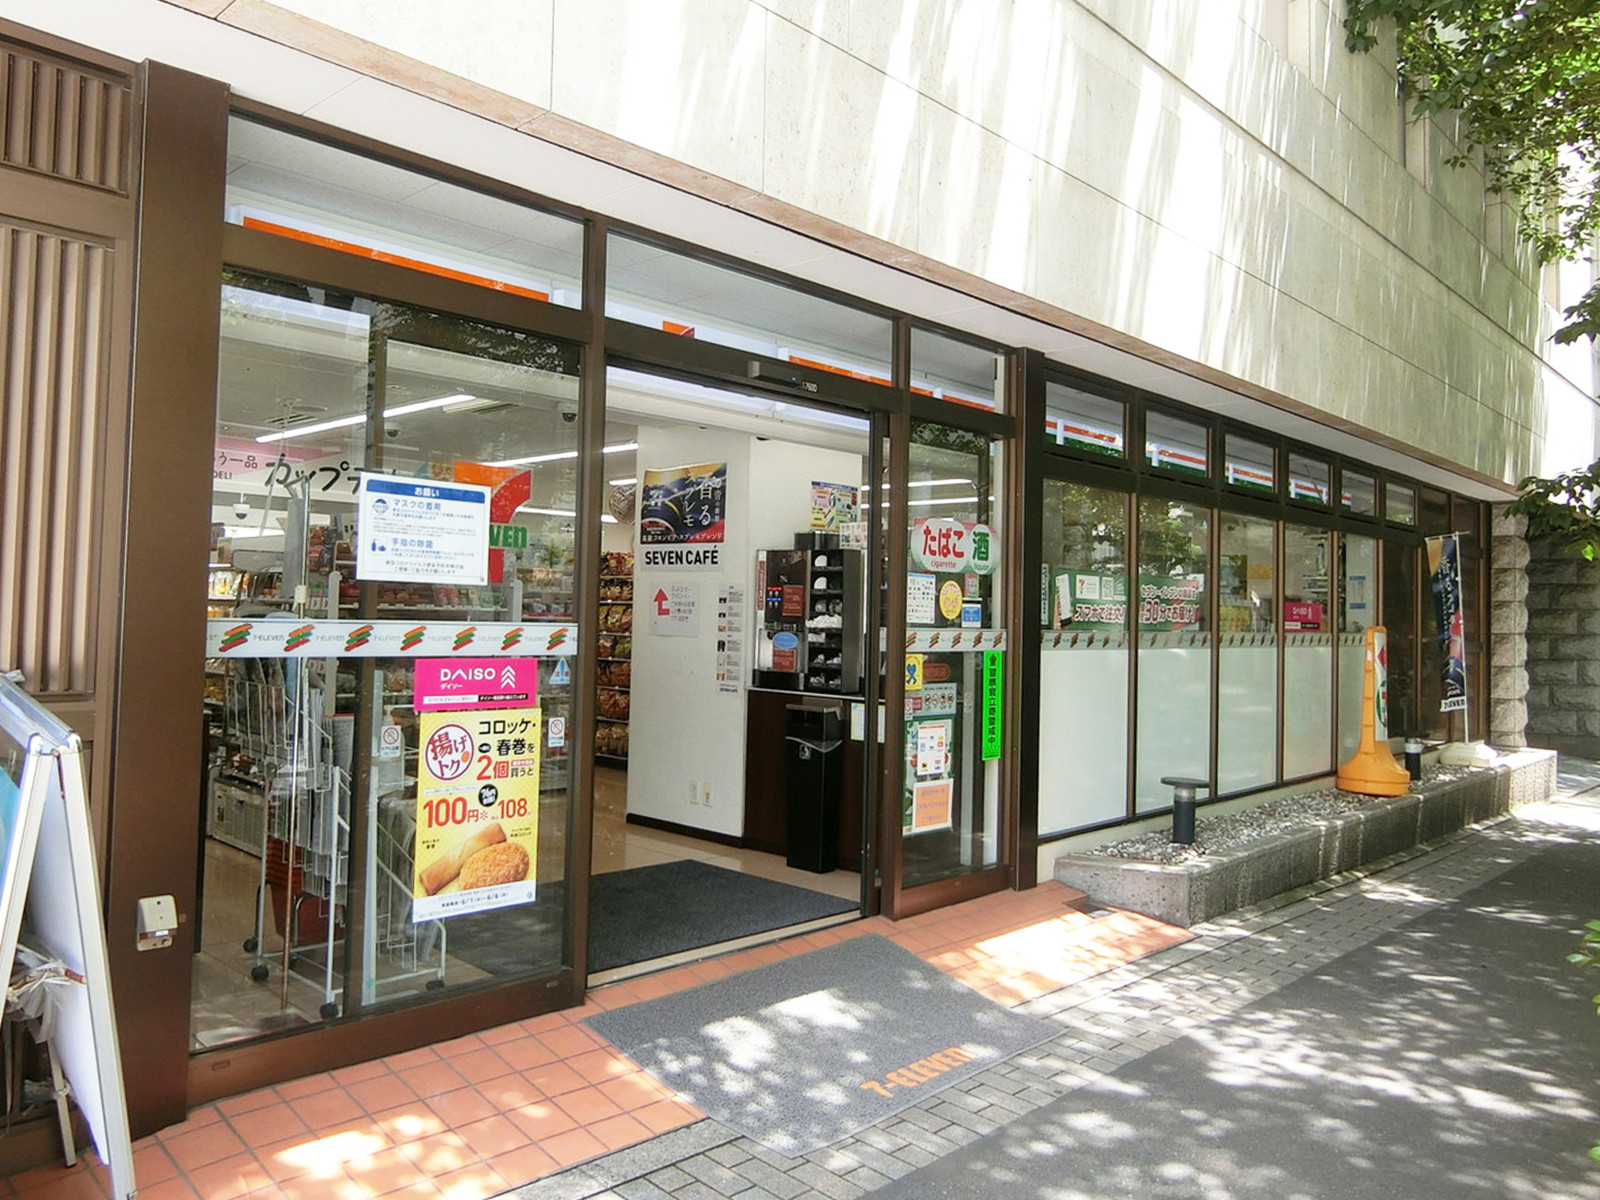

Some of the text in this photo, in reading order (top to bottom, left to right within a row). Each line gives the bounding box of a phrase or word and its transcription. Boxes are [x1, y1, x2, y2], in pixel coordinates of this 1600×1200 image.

[414, 487, 440, 498] お願い
[393, 498, 442, 511] マスクの着用
[923, 525, 989, 561] たばこ 酒
[645, 546, 719, 565] SEVEN CAFÉ
[440, 668, 496, 681] DAISO
[476, 755, 509, 781] 2個
